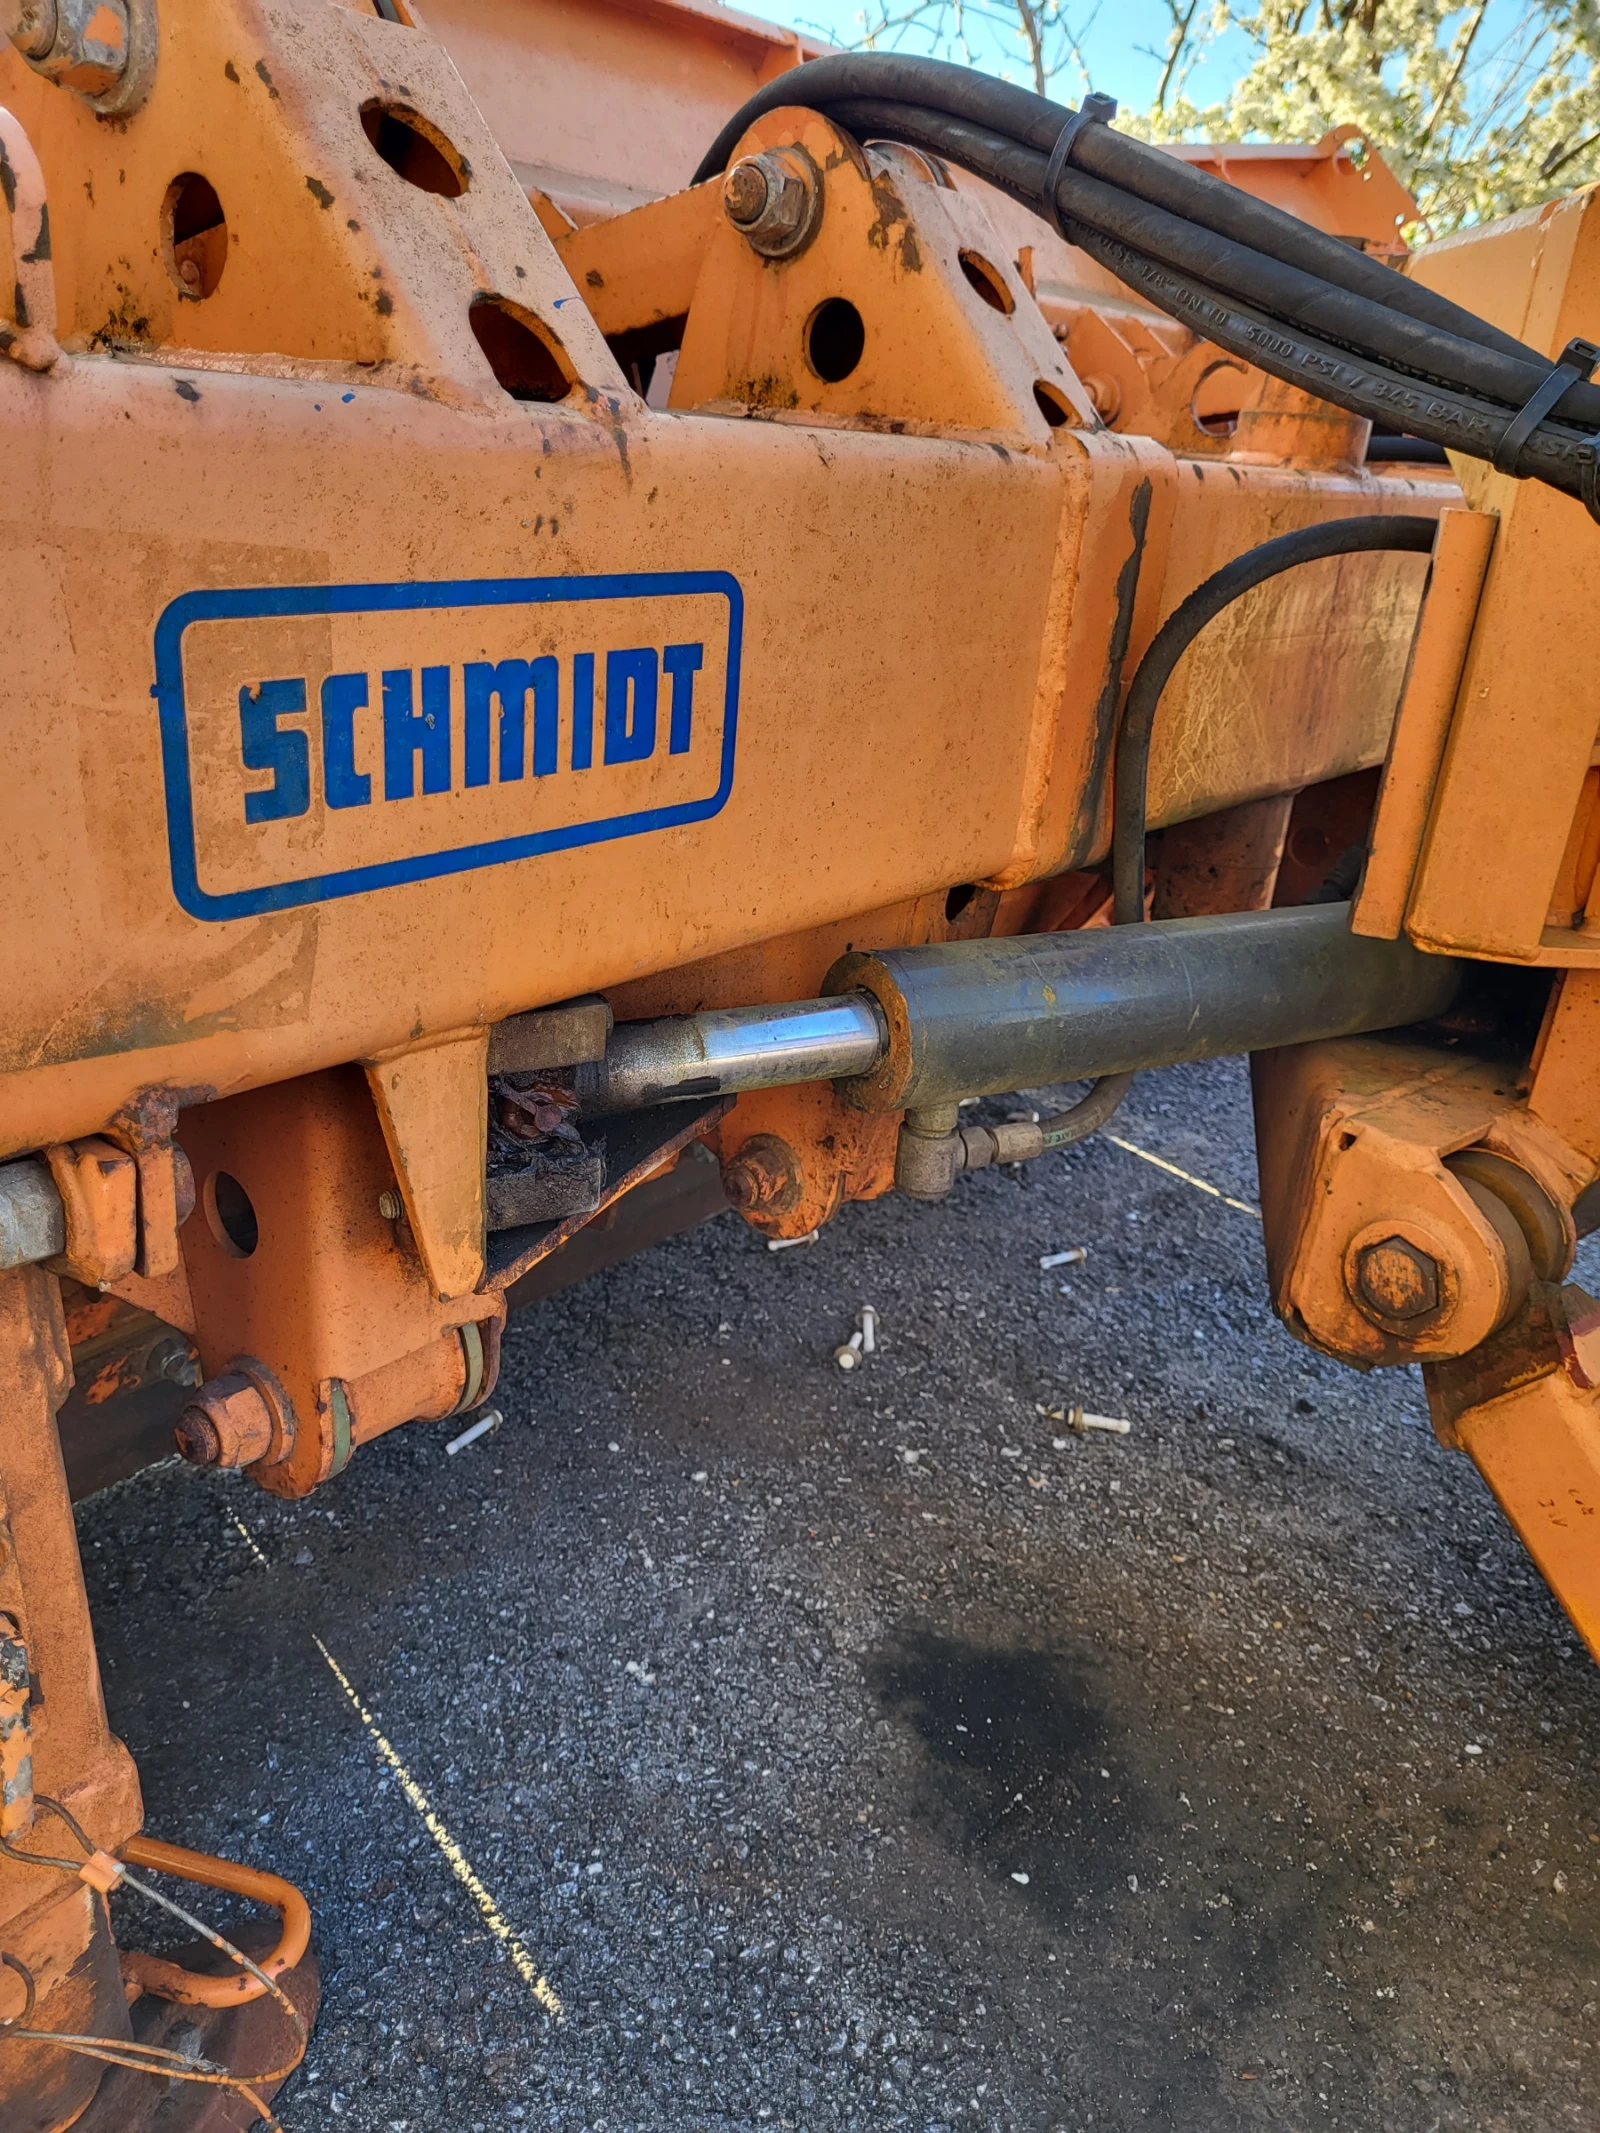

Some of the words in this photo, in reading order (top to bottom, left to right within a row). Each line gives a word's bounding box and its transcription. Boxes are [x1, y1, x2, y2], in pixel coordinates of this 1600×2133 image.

[1175, 288, 1201, 310] DN
[1208, 305, 1227, 325] 10
[1247, 325, 1294, 357] 5000
[1301, 352, 1341, 380] PSI
[1372, 381, 1420, 408] 345
[1426, 402, 1491, 434] BAR
[238, 643, 704, 824] SCHMIDT
